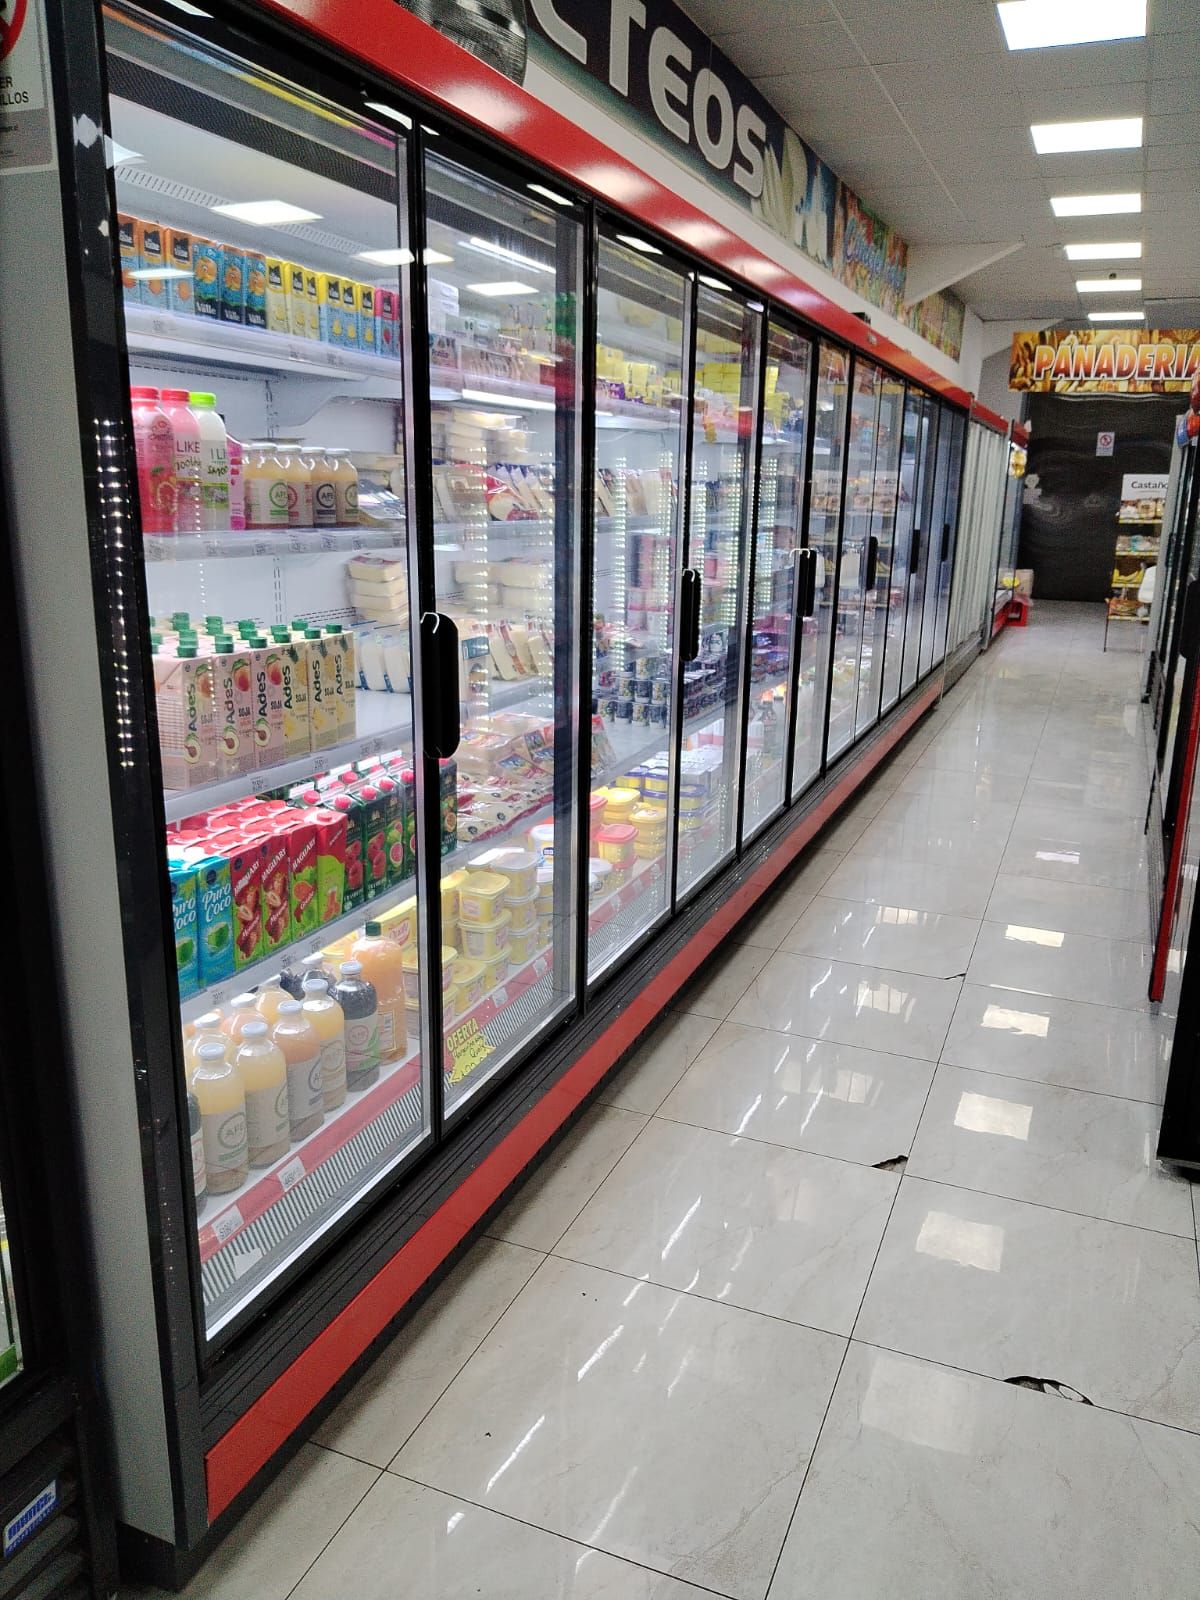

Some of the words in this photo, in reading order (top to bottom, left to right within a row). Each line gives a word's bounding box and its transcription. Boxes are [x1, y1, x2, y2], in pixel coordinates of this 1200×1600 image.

[257, 671, 267, 717] AdeS
[282, 664, 293, 710] AdeS
[202, 882, 231, 911] Puro
[205, 895, 231, 923] Coco
[447, 1017, 479, 1051] OFERTA
